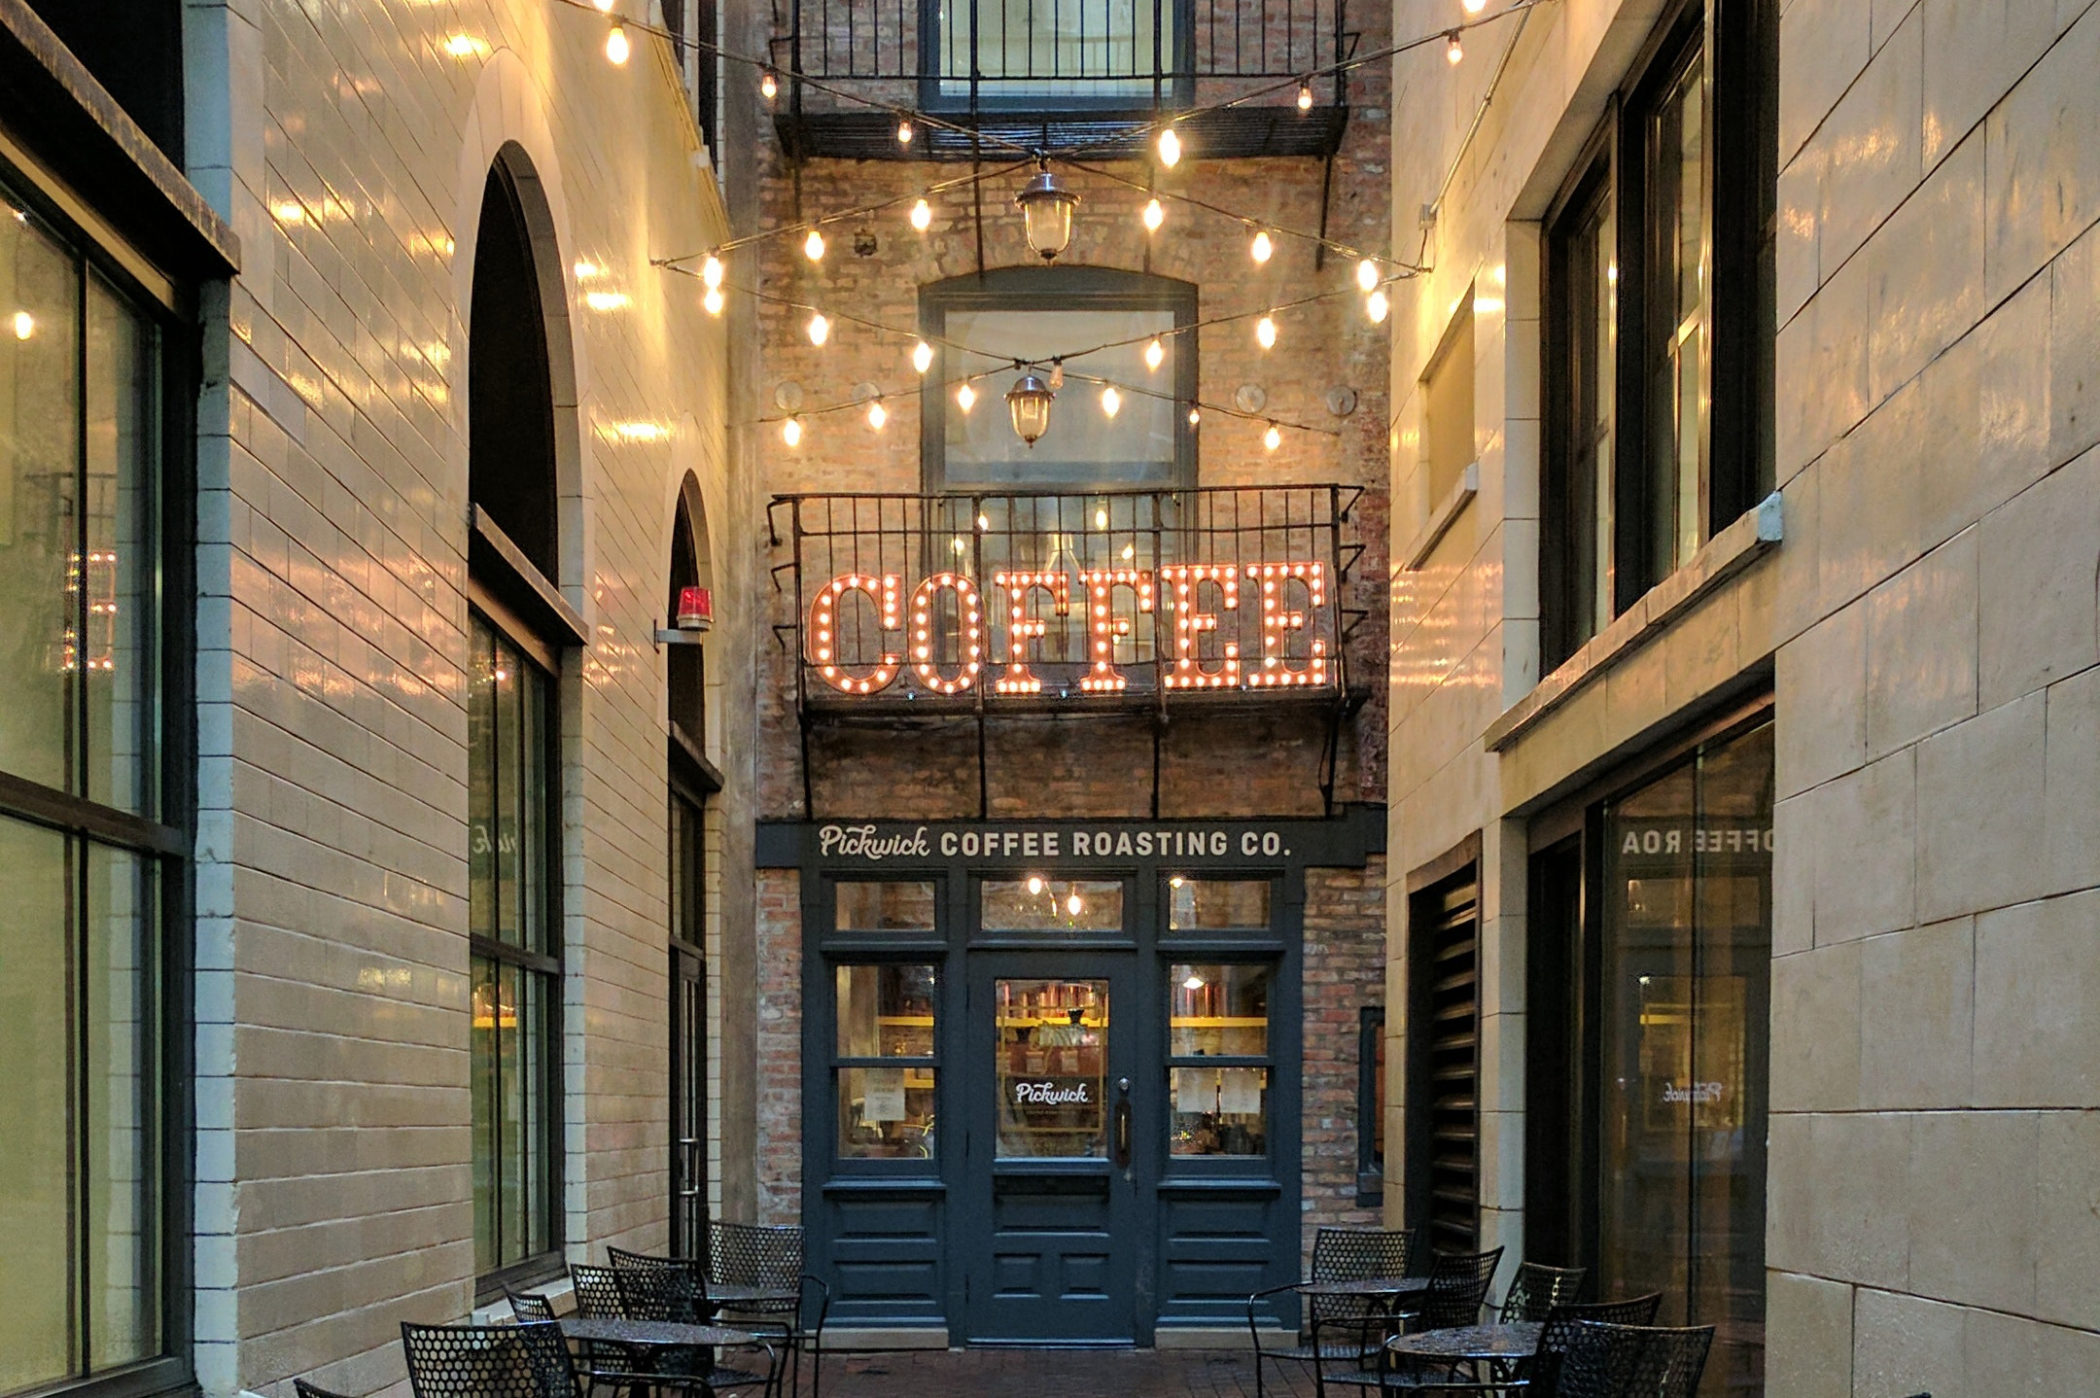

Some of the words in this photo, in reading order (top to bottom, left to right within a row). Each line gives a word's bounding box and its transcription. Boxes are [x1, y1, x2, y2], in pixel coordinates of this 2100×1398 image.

[809, 561, 1326, 695] COFFEE
[819, 824, 931, 860] Pickwick
[940, 831, 1060, 856] COFFEE
[1073, 831, 1228, 856] ROASTING
[1241, 831, 1291, 856] CO.
[1016, 1082, 1089, 1105] Pickwick
